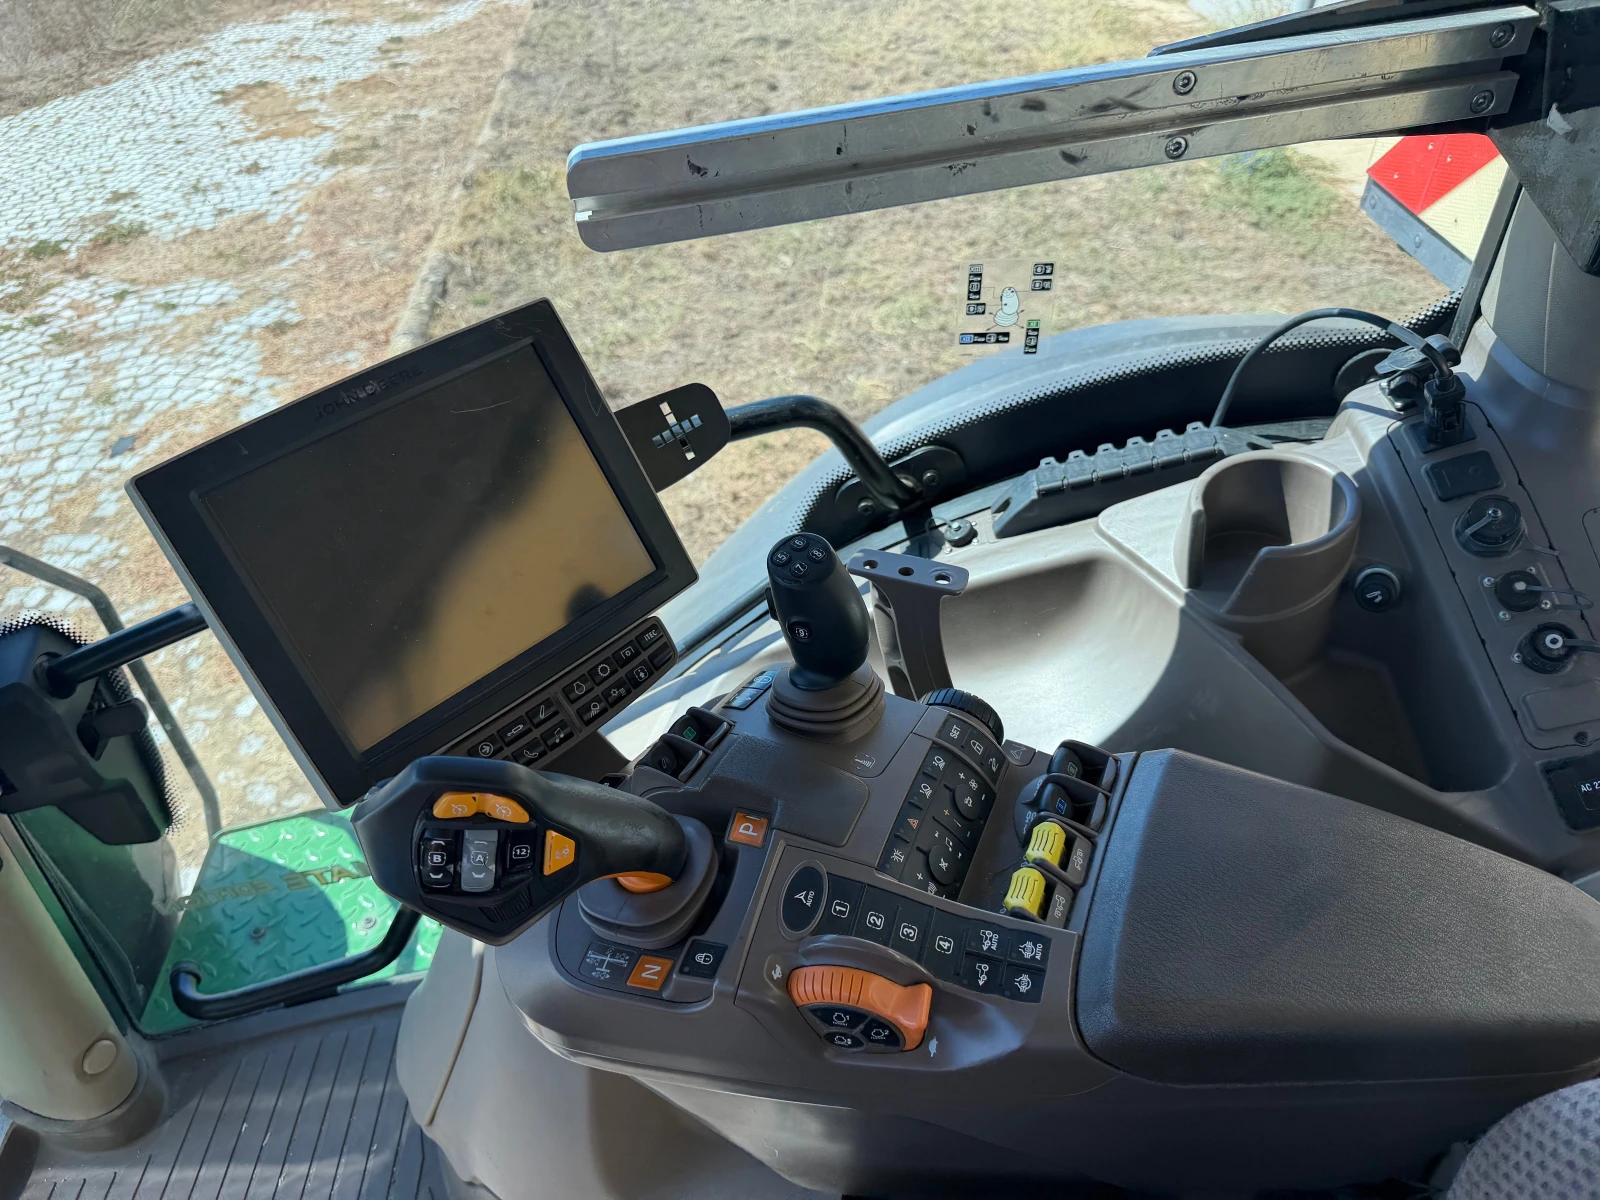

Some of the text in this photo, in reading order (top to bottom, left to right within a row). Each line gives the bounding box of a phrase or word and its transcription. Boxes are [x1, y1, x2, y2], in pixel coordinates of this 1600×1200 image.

[949, 724, 961, 740] SET
[1580, 783, 1592, 792] AC
[515, 848, 527, 856] 12
[432, 854, 442, 863] B
[475, 854, 485, 863] A
[805, 890, 815, 907] AUTO
[869, 915, 882, 926] 2
[903, 927, 915, 937] 3
[939, 940, 951, 950] 4
[990, 933, 999, 951] AUTO
[1034, 943, 1043, 961] AUTO
